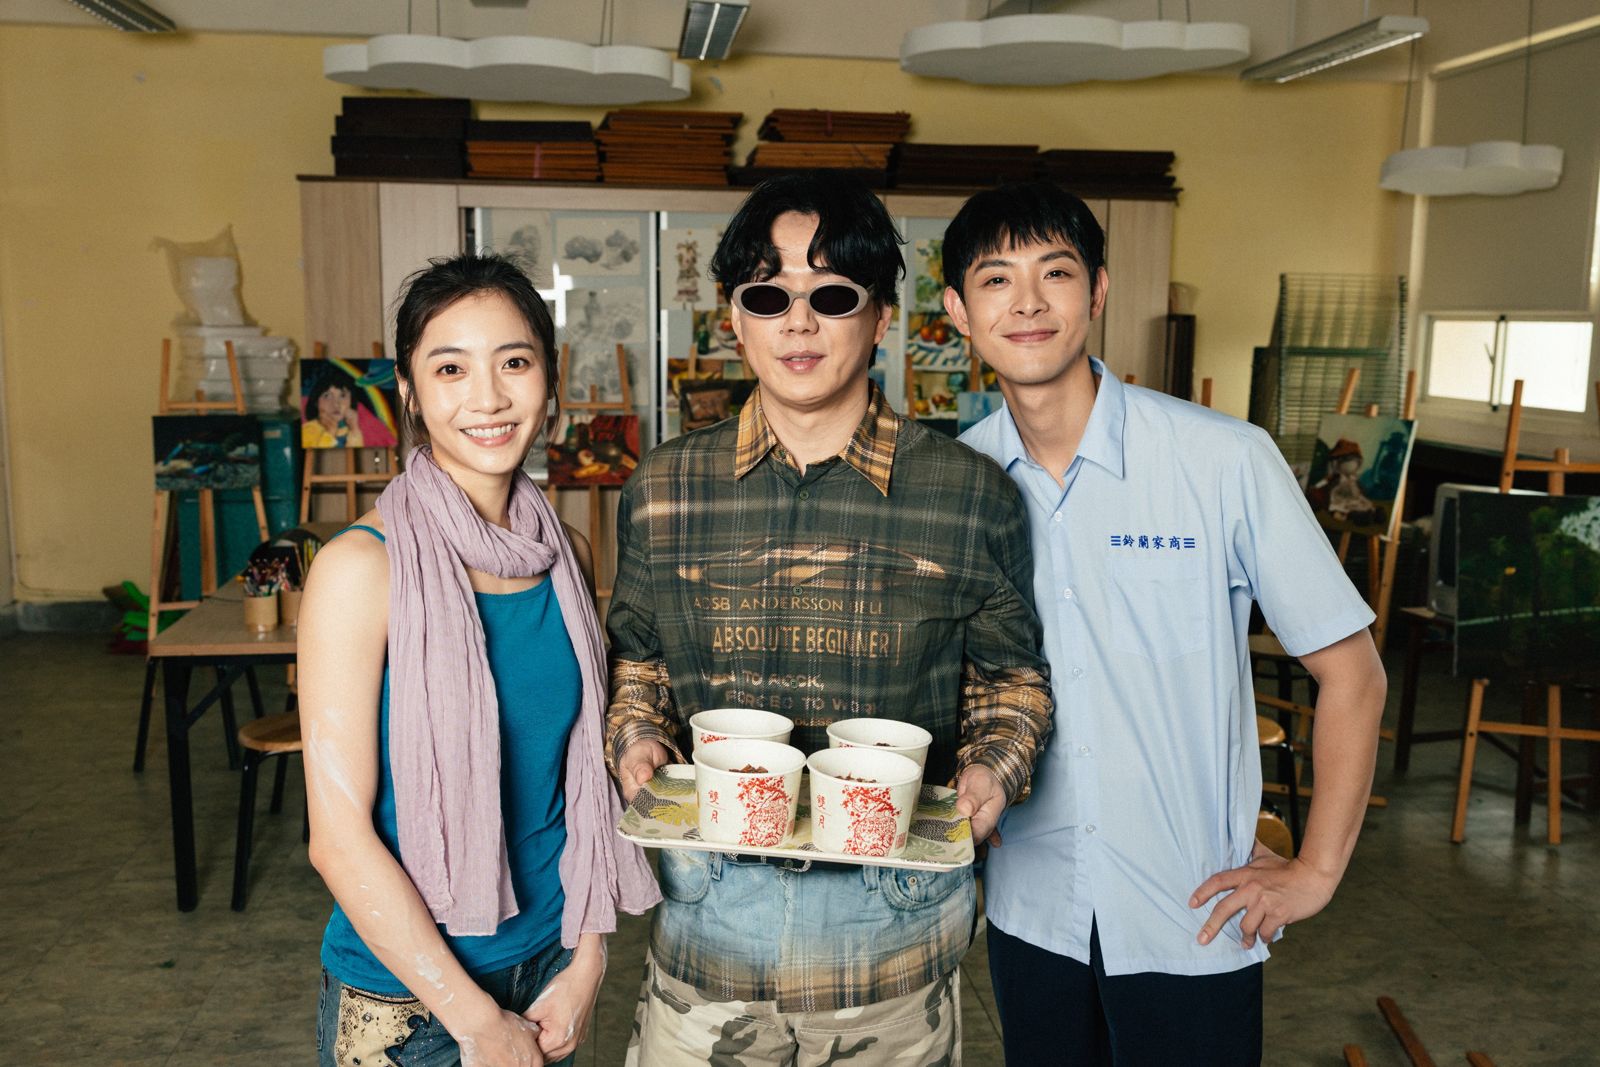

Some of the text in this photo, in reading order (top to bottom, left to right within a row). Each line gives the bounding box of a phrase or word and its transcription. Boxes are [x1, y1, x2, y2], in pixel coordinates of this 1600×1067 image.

[1122, 534, 1181, 550] 鈴蘭家商
[740, 595, 844, 612] ANDERSSON
[712, 625, 889, 658] ABSOLUTE BEGINNER
[742, 669, 763, 686] TO
[801, 696, 825, 711] TO
